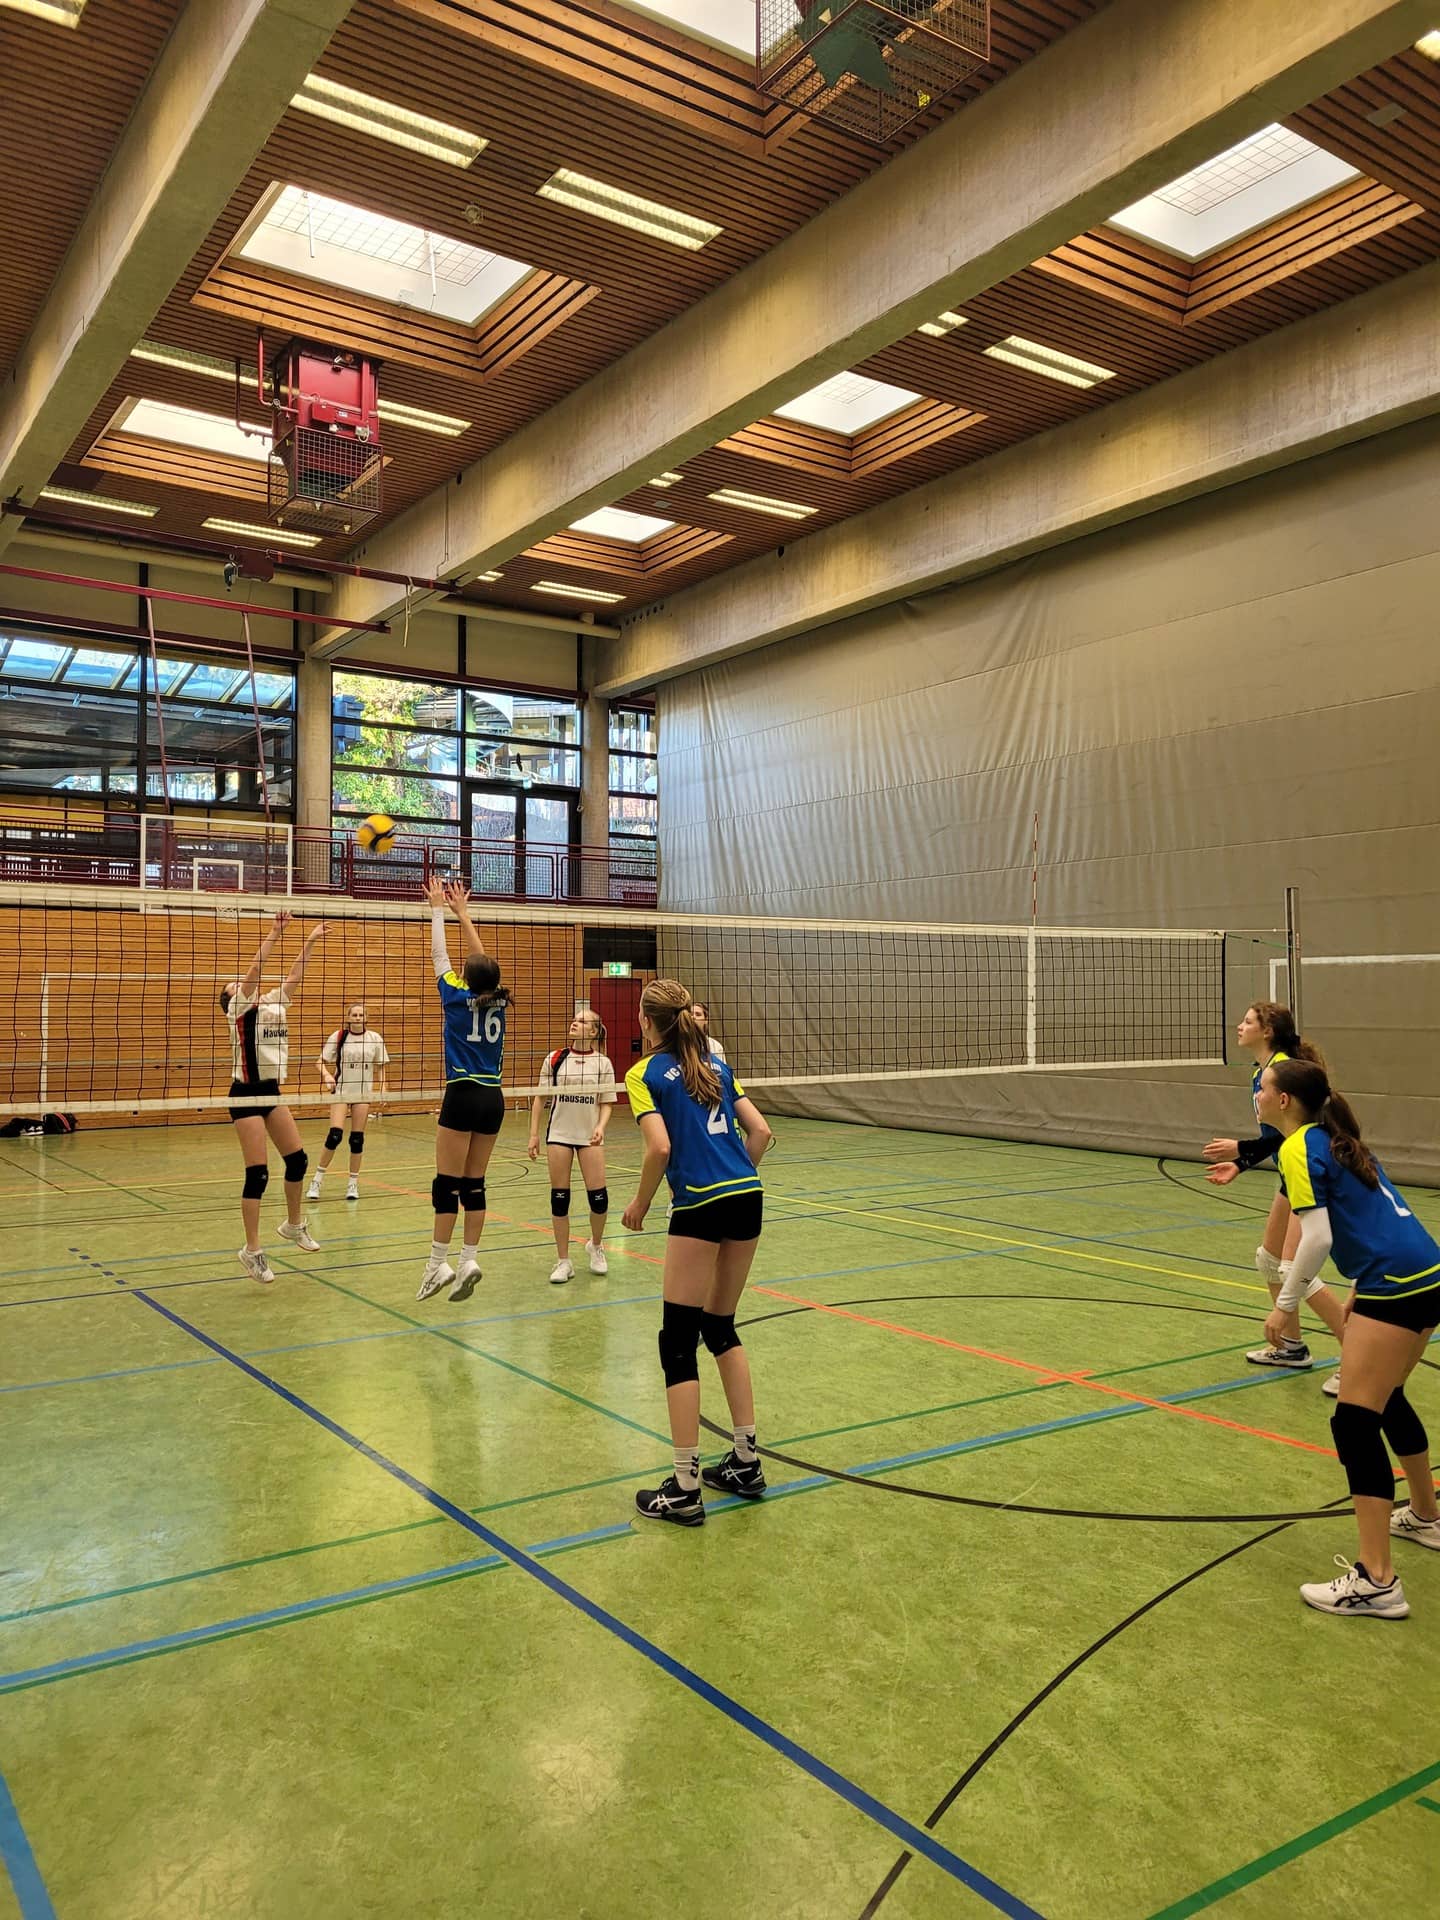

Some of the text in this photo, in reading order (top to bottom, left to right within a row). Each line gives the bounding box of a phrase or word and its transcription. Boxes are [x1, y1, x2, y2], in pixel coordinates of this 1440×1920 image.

[466, 1005, 501, 1043] 16
[263, 1028, 288, 1039] Hausac
[559, 1094, 595, 1105] Hausach
